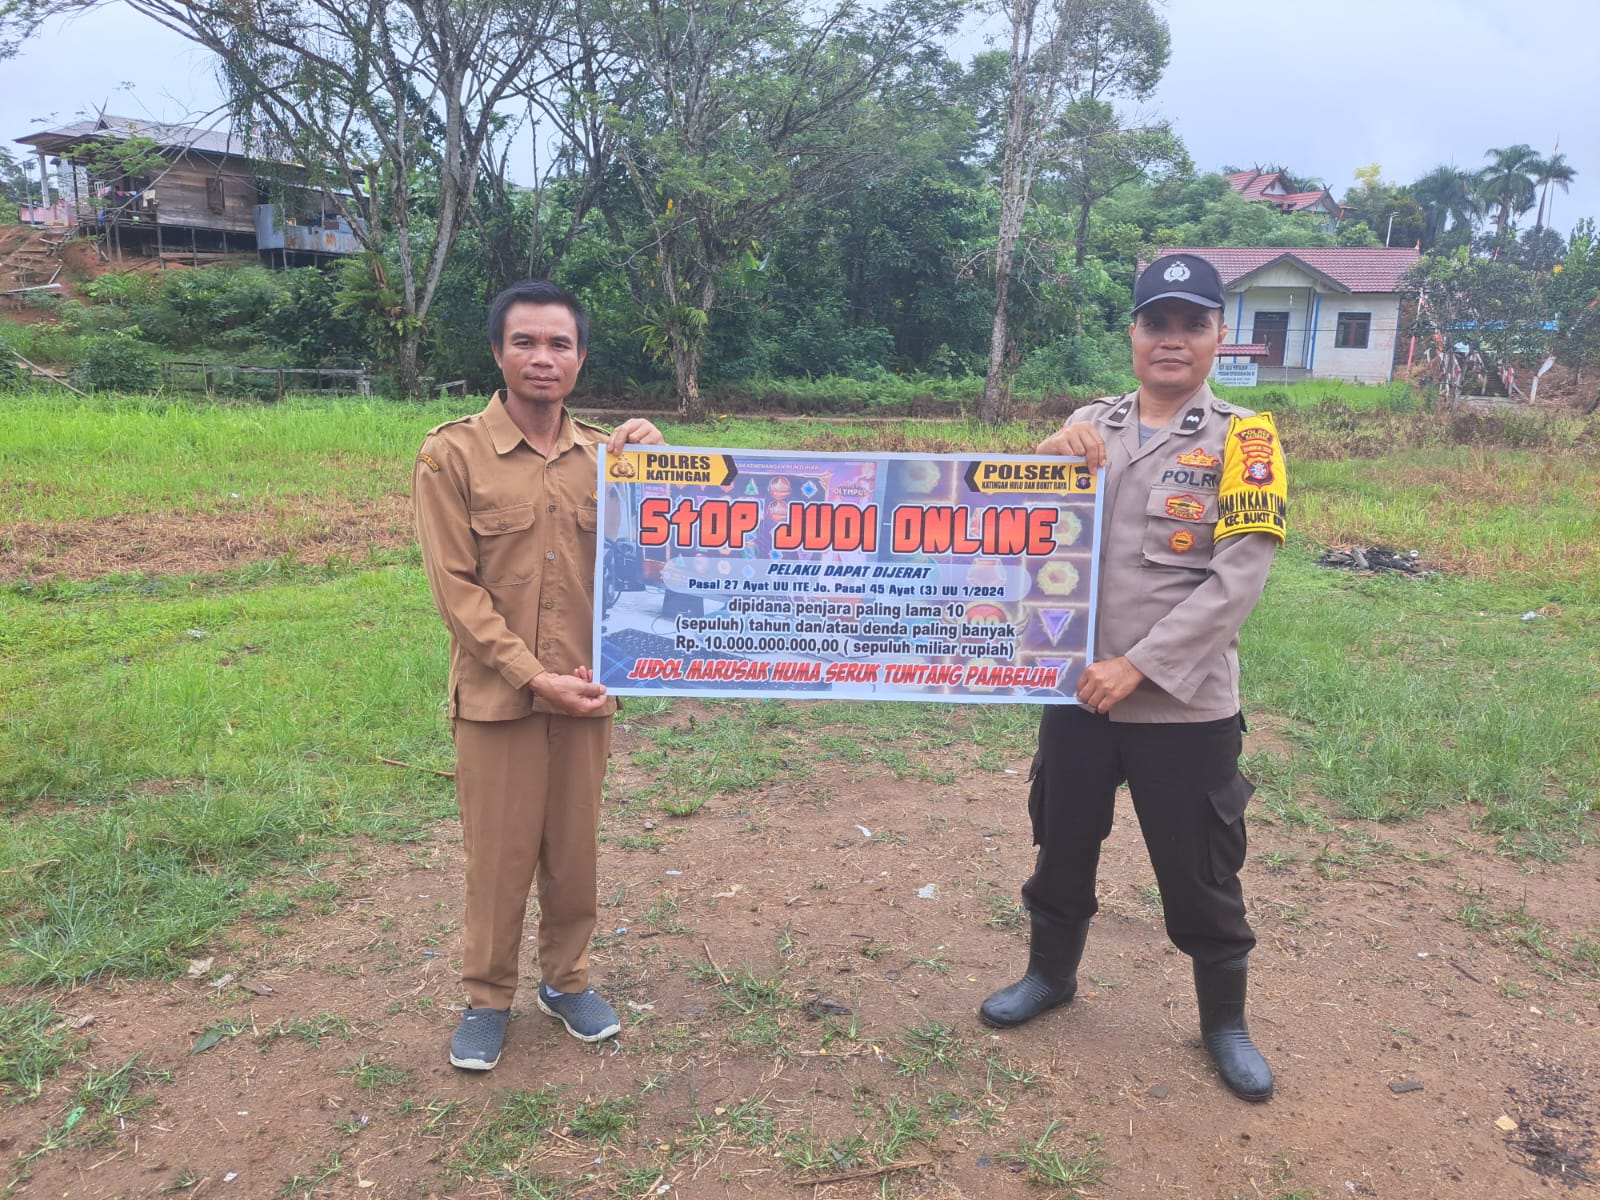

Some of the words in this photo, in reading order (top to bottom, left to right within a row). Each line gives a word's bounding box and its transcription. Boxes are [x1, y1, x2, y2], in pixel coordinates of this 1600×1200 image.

[646, 454, 711, 470] POLRES
[983, 464, 1066, 480] POLSEK
[646, 470, 711, 482] KATINGAN
[981, 481, 1009, 490] KATINGAN
[1009, 481, 1023, 490] HULU
[1024, 482, 1035, 490] DAN
[1036, 482, 1053, 490] BUKIT
[774, 502, 878, 553] JUDI
[892, 504, 1059, 556] ONLINE
[767, 563, 822, 577] PELAKU
[824, 565, 871, 578] DAPAT
[872, 566, 932, 579] DIJERAT
[688, 578, 720, 590] Pasal
[724, 579, 739, 590] 27
[743, 580, 770, 592] Ayat
[773, 581, 789, 591] UU
[793, 581, 809, 591] ITE
[813, 582, 831, 593] Jo.
[835, 583, 866, 594] Pasal
[869, 583, 885, 594] 45
[889, 584, 915, 597] Ayat
[919, 584, 938, 596] (3)
[941, 586, 958, 596] UU
[962, 586, 1005, 598] 1/2024
[728, 598, 791, 614] dipidana
[796, 600, 851, 617] penjara
[856, 602, 901, 619] paling
[905, 603, 942, 617] lama
[946, 604, 964, 617] 10
[676, 615, 744, 633] (sepuluh)
[749, 618, 791, 633] tahun
[795, 619, 859, 635] dan/atau
[863, 622, 908, 635] denda
[912, 622, 957, 639] paling
[962, 623, 1015, 640] banyak
[676, 635, 699, 651] Rp.
[853, 640, 911, 655] sepuluh
[915, 641, 957, 654] miliar
[962, 642, 1014, 659] rupiah)
[629, 658, 682, 679] JUDOL
[685, 659, 771, 681] MARUSAK
[771, 660, 822, 682] HUMA
[825, 662, 882, 683] SERUK
[884, 664, 964, 686] TUNTANG
[964, 666, 1059, 688] PAMBELUM
